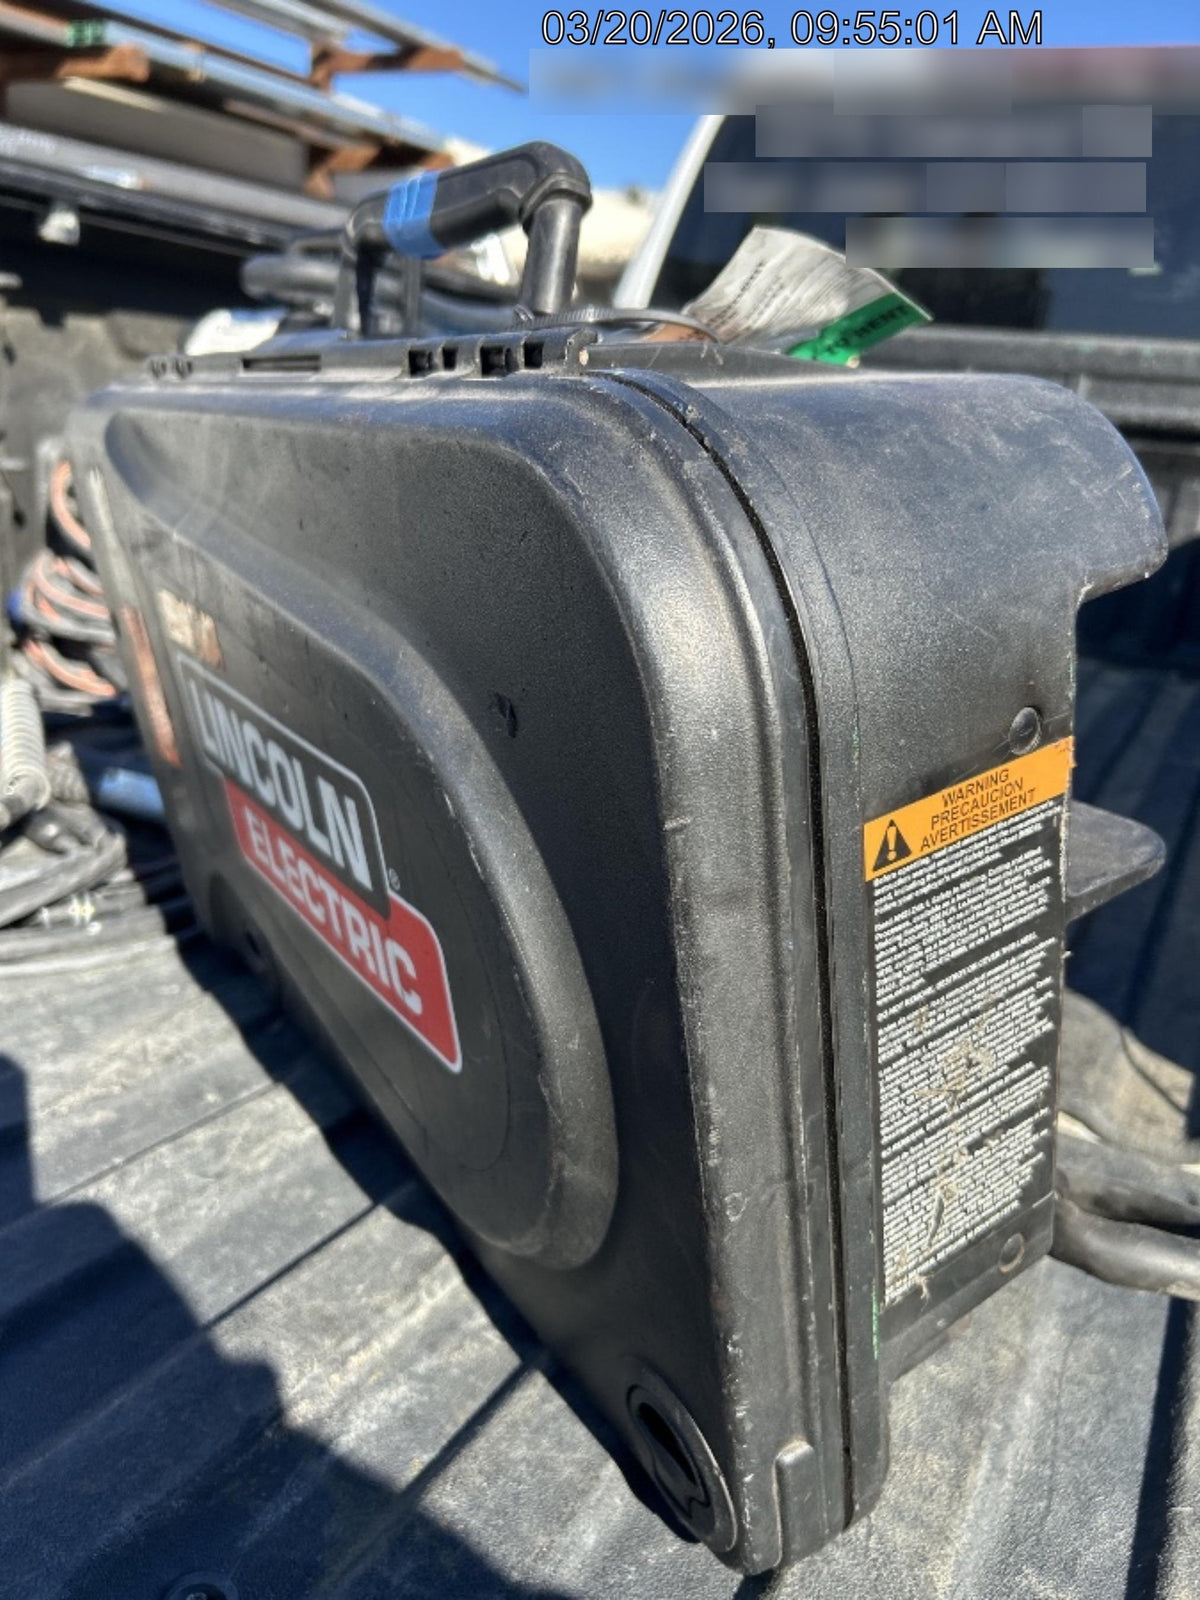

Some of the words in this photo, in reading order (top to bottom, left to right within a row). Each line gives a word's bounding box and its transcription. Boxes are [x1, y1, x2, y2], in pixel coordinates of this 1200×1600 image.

[189, 678, 373, 891] LINCOLN
[931, 777, 1024, 830] PRECAUCION
[942, 769, 1009, 808] WARNING
[920, 787, 1036, 852] AVERTISSEMENT
[244, 807, 422, 1016] ELECTRIC
